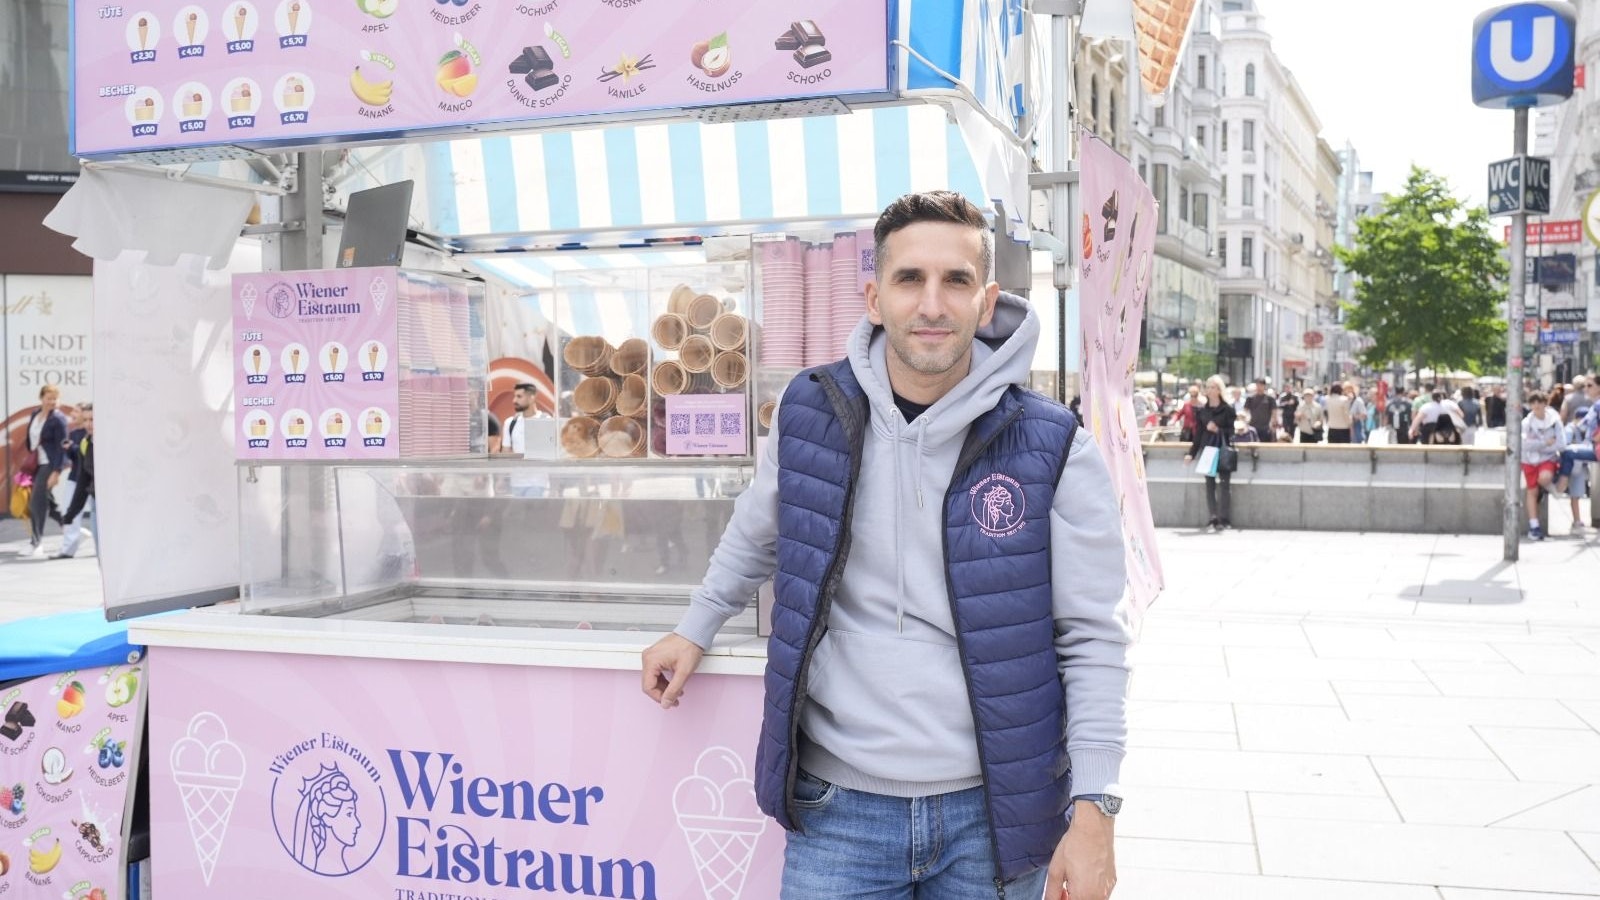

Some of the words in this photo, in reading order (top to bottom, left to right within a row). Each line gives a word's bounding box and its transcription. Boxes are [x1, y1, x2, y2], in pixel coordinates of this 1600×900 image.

[98, 5, 123, 19] TÜTE
[430, 4, 482, 26] HEIDELBEER
[361, 23, 389, 33] APFEL
[1490, 15, 1555, 82] U
[686, 70, 743, 92] HASELNUSS
[786, 68, 832, 85] SCHOKO
[99, 84, 136, 97] BECHER
[507, 79, 537, 108] DUNKLE
[539, 74, 572, 107] SCHOKO
[608, 83, 647, 99] VANILLE
[358, 104, 394, 119] BANANE
[438, 99, 473, 113] MANGO
[1489, 160, 1519, 191] WC
[1526, 160, 1549, 189] WC
[296, 282, 349, 299] Wiener
[298, 299, 361, 316] Eistraum
[20, 334, 87, 351] LINDT
[20, 355, 87, 366] FLAGSHIP
[19, 369, 88, 386] STORE
[242, 397, 274, 406] BECHER
[969, 476, 991, 495] Wiener
[107, 712, 129, 722] APFEL
[10, 732, 35, 756] SCHOKO
[269, 736, 317, 776] Wiener
[321, 732, 381, 783] Eistraum
[88, 765, 126, 787] HEIDELBEER
[35, 781, 73, 804] KOKOSNUSS
[385, 749, 604, 826] Wiener
[75, 840, 114, 863] CAPPUCCINO
[395, 816, 656, 900] Eistraum
[25, 871, 52, 886] BANANE
